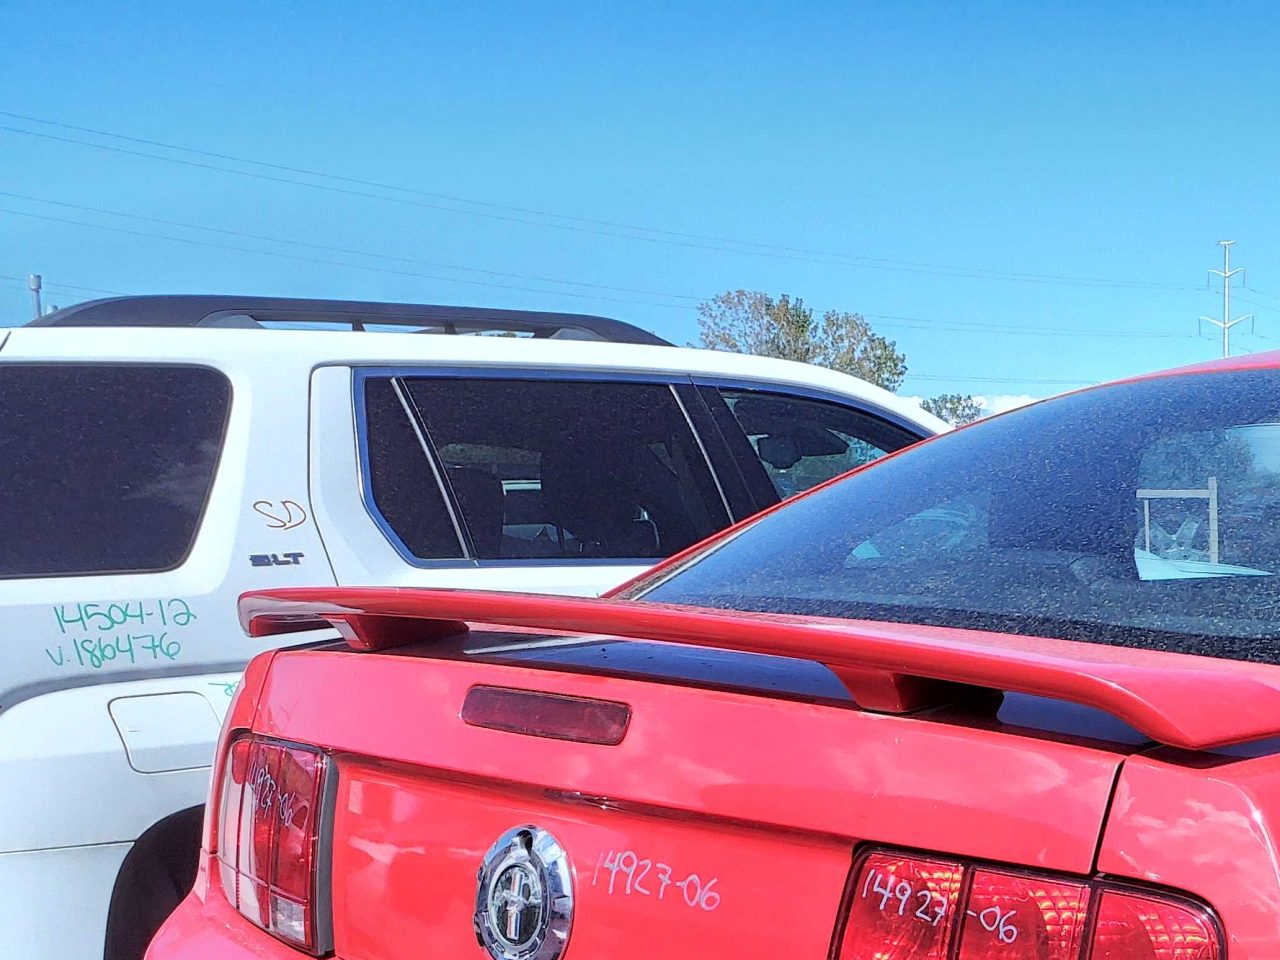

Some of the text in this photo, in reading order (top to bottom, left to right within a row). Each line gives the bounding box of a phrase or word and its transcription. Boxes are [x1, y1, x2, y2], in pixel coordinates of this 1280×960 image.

[249, 552, 305, 567] SLT
[53, 598, 198, 634] 14504-12
[591, 849, 721, 912] 14927-06
